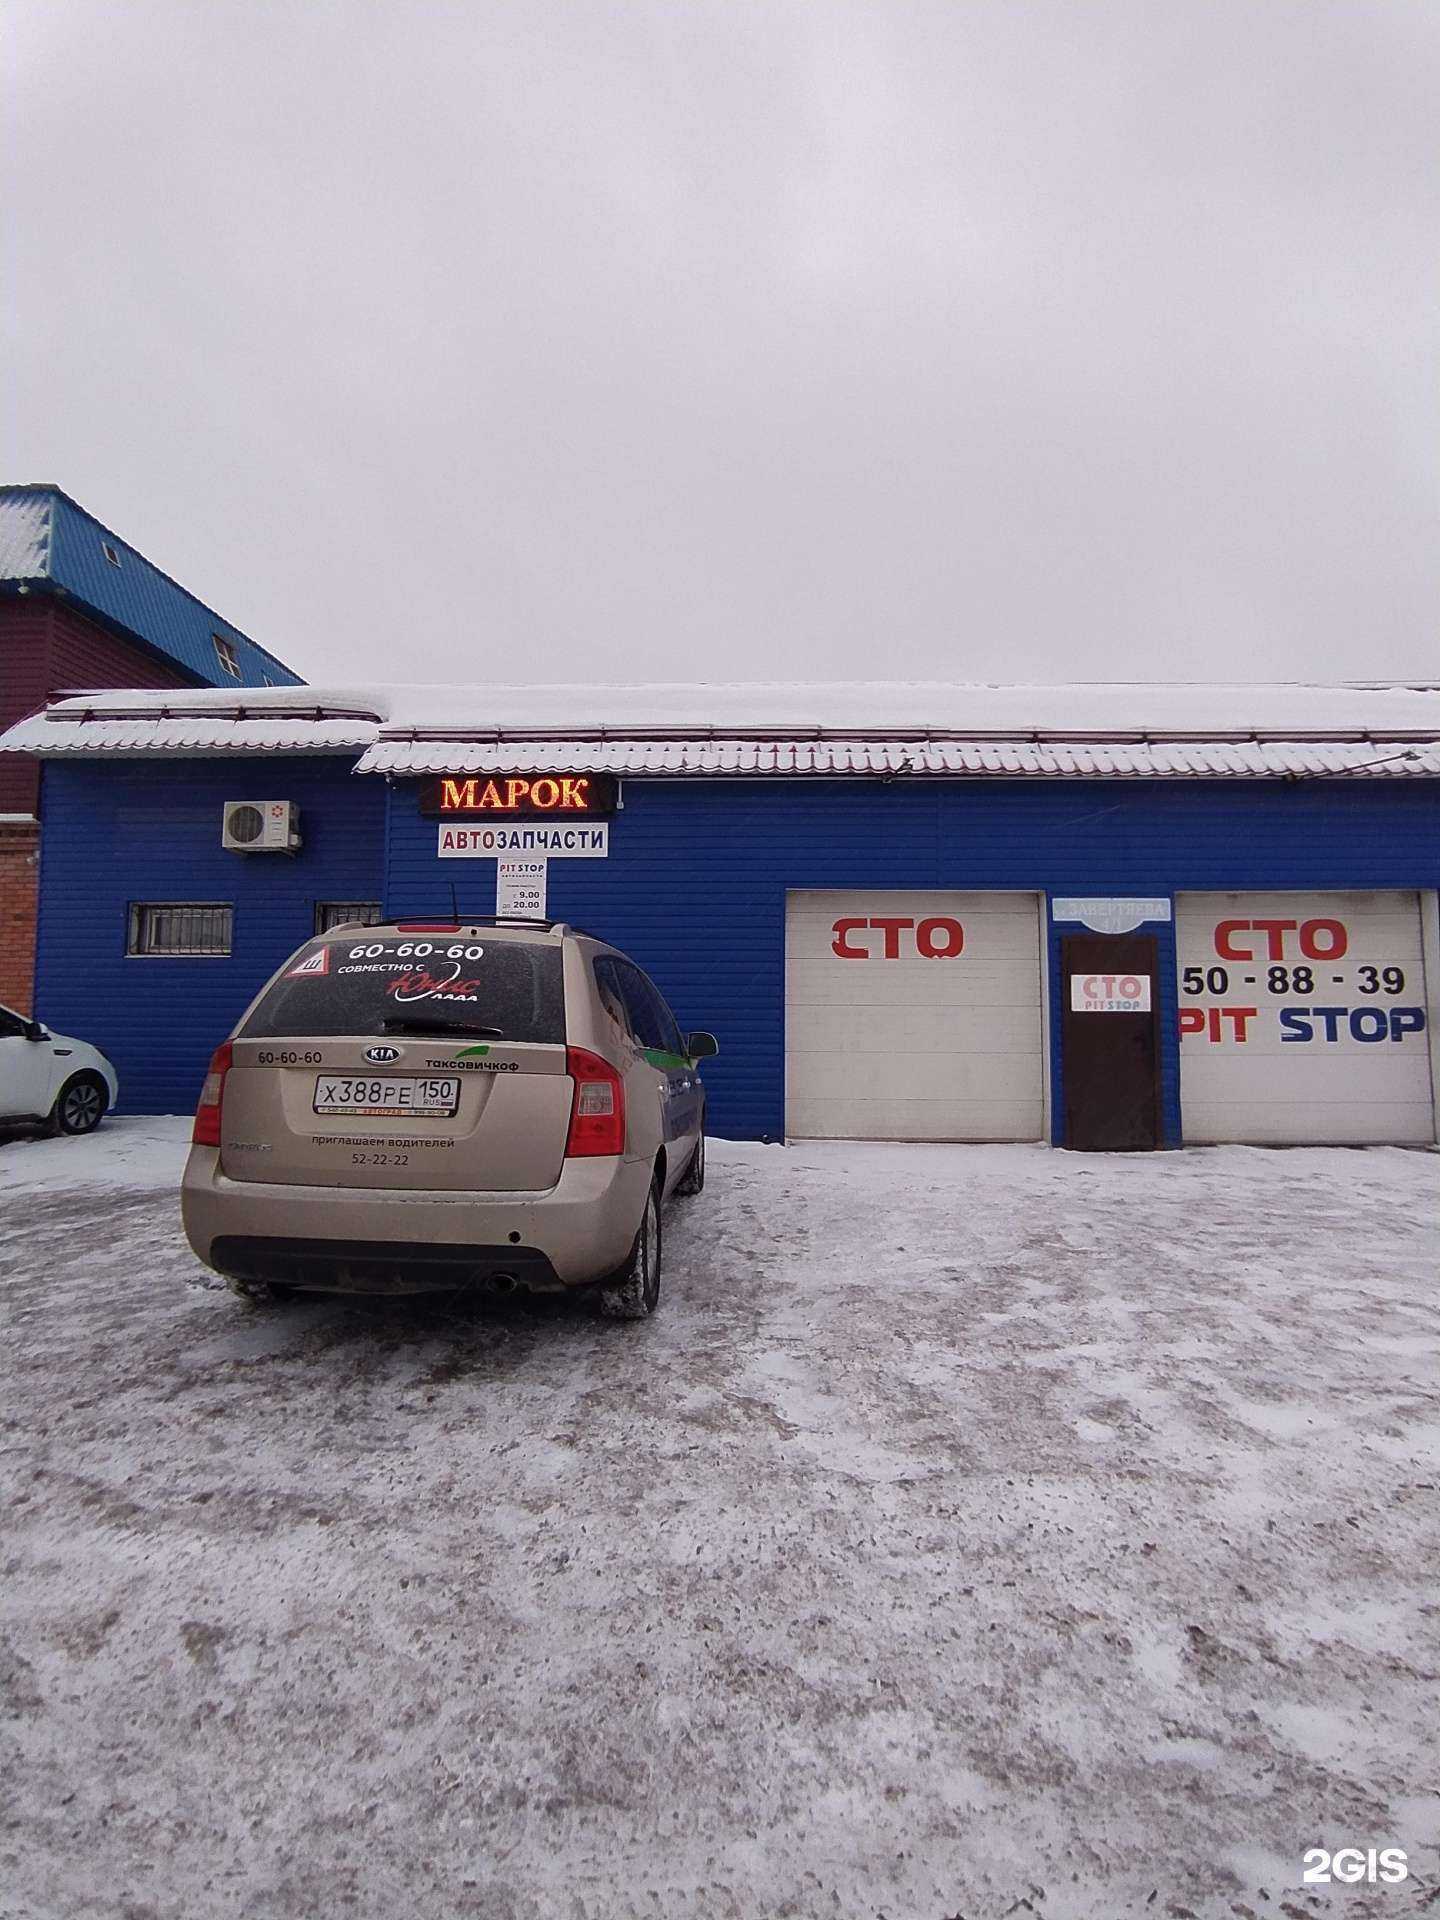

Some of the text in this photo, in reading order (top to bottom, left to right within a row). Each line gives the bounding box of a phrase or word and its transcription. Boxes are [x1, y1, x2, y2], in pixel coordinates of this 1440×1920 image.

[440, 778, 588, 809] МАРОК
[442, 830, 604, 850] АВТОЗАПЧАСТИ
[519, 891, 540, 899] 9.00
[513, 901, 540, 909] 20.00
[831, 918, 963, 959] СТО
[1214, 919, 1348, 961] СТО
[349, 943, 484, 960] 60-60-60
[338, 963, 413, 974] СОВМЕСТНО
[1083, 976, 1142, 999] СТО
[1183, 966, 1229, 995] 50
[1267, 966, 1314, 995] 88
[1358, 966, 1405, 995] 39
[1178, 1007, 1426, 1043] PIT STOP
[258, 1052, 323, 1065] 60-60-60
[371, 1049, 395, 1060] KIA
[424, 1058, 520, 1072] таксовичкоф
[323, 1080, 451, 1105] Х388РЕ 150
[423, 1099, 441, 1107] RUS
[311, 1135, 455, 1150] приглашаем водителей
[351, 1153, 409, 1167] 52-22-22
